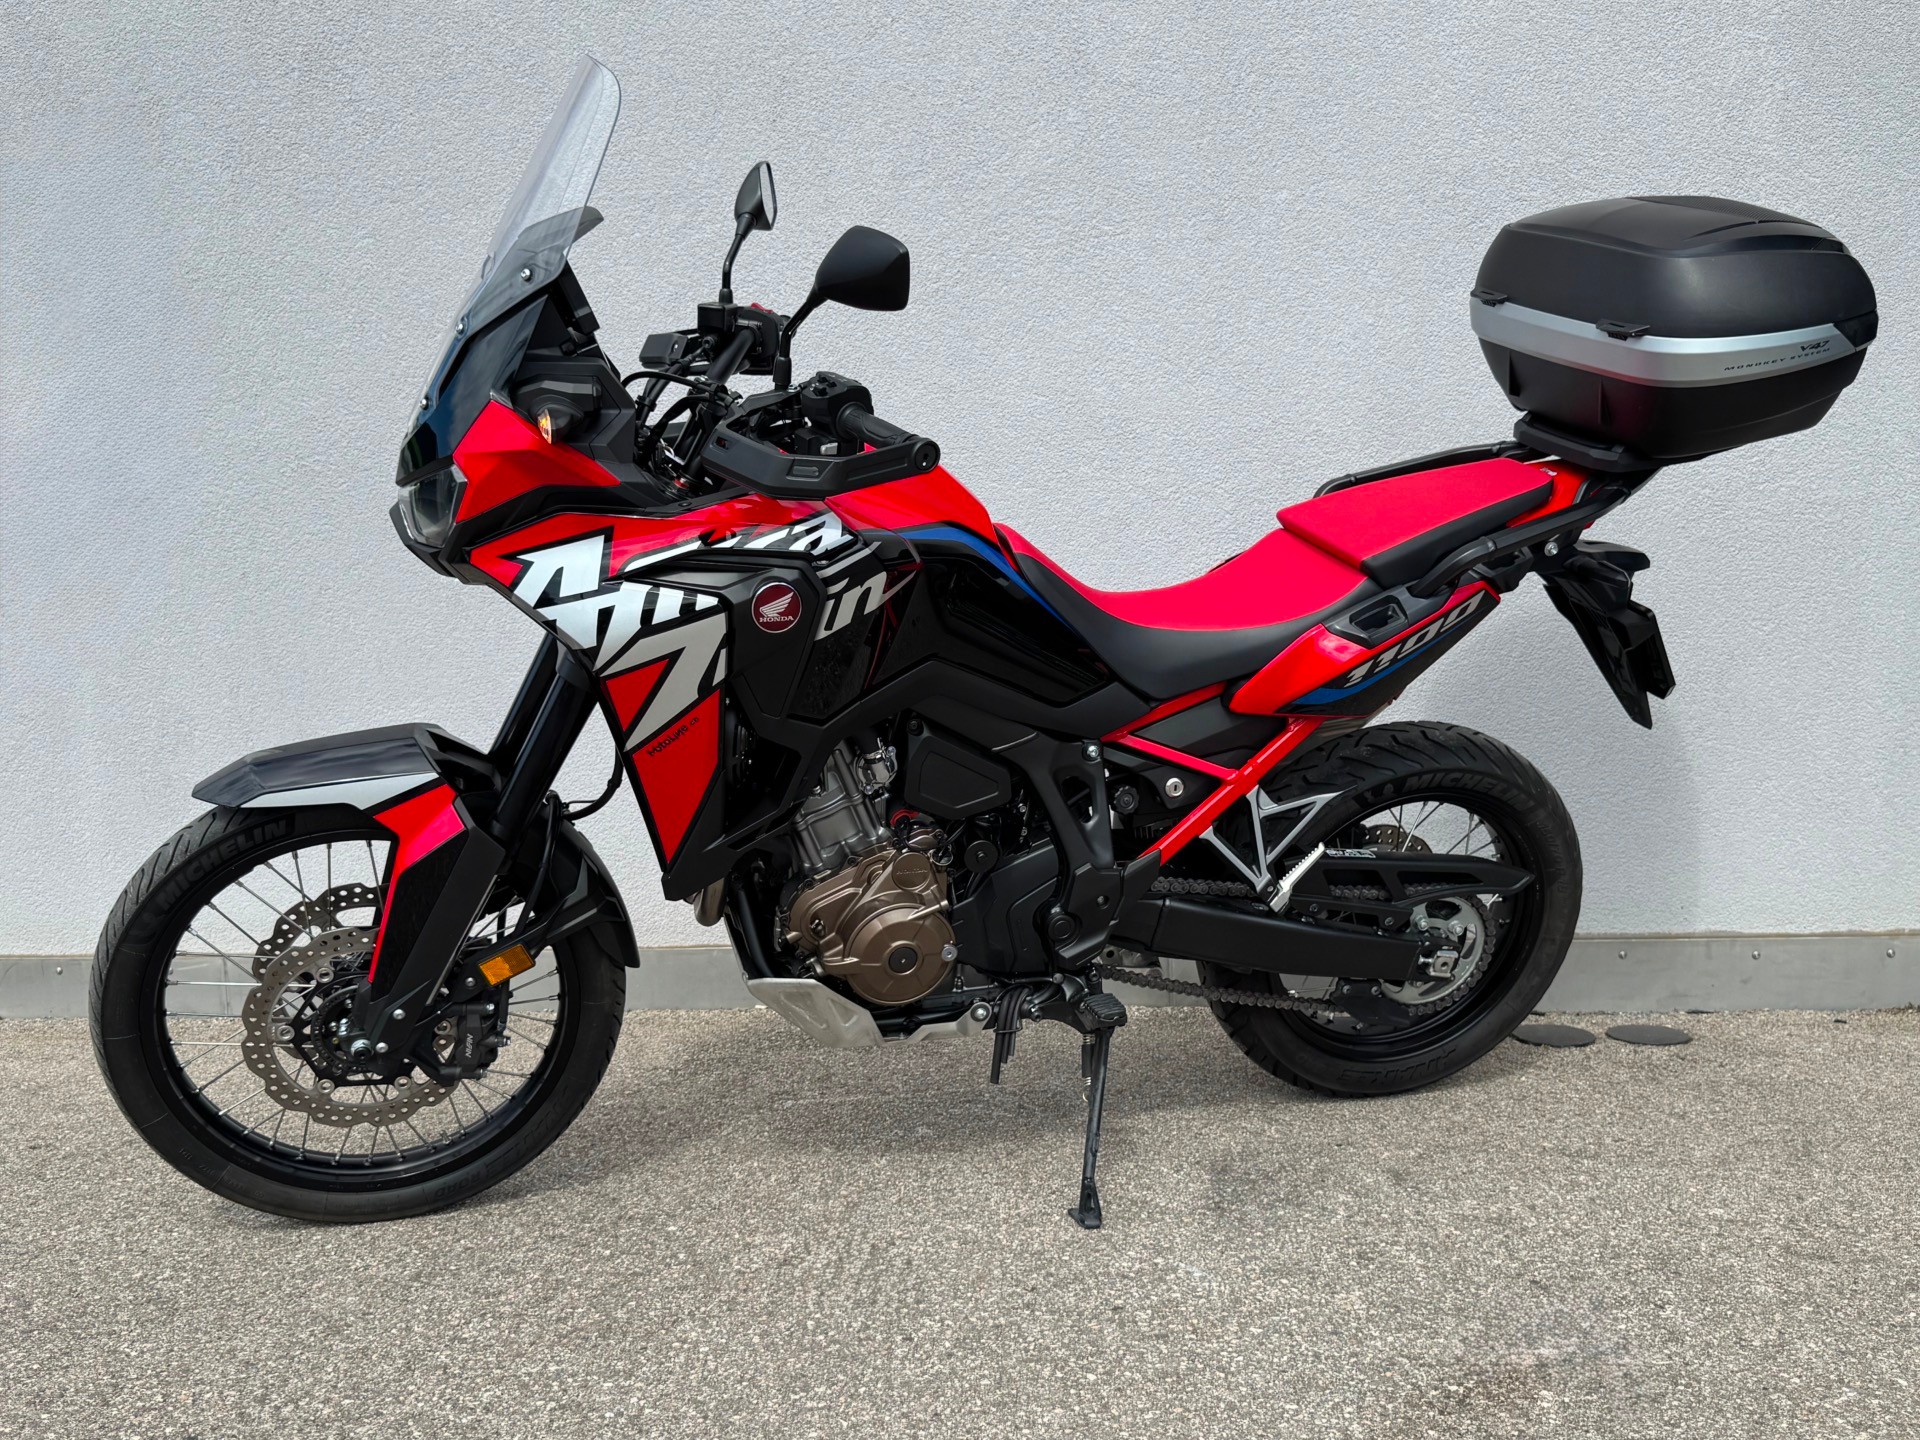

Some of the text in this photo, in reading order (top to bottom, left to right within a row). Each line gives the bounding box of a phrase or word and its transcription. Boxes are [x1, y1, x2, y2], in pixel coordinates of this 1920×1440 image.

[1723, 347, 1831, 371] MONOKEY SYSTEM
[1800, 339, 1831, 352] V47
[759, 615, 795, 623] HONDA
[1343, 589, 1486, 688] 1100
[1402, 771, 1537, 813] MICHELIN
[155, 818, 288, 911] MICHELIN
